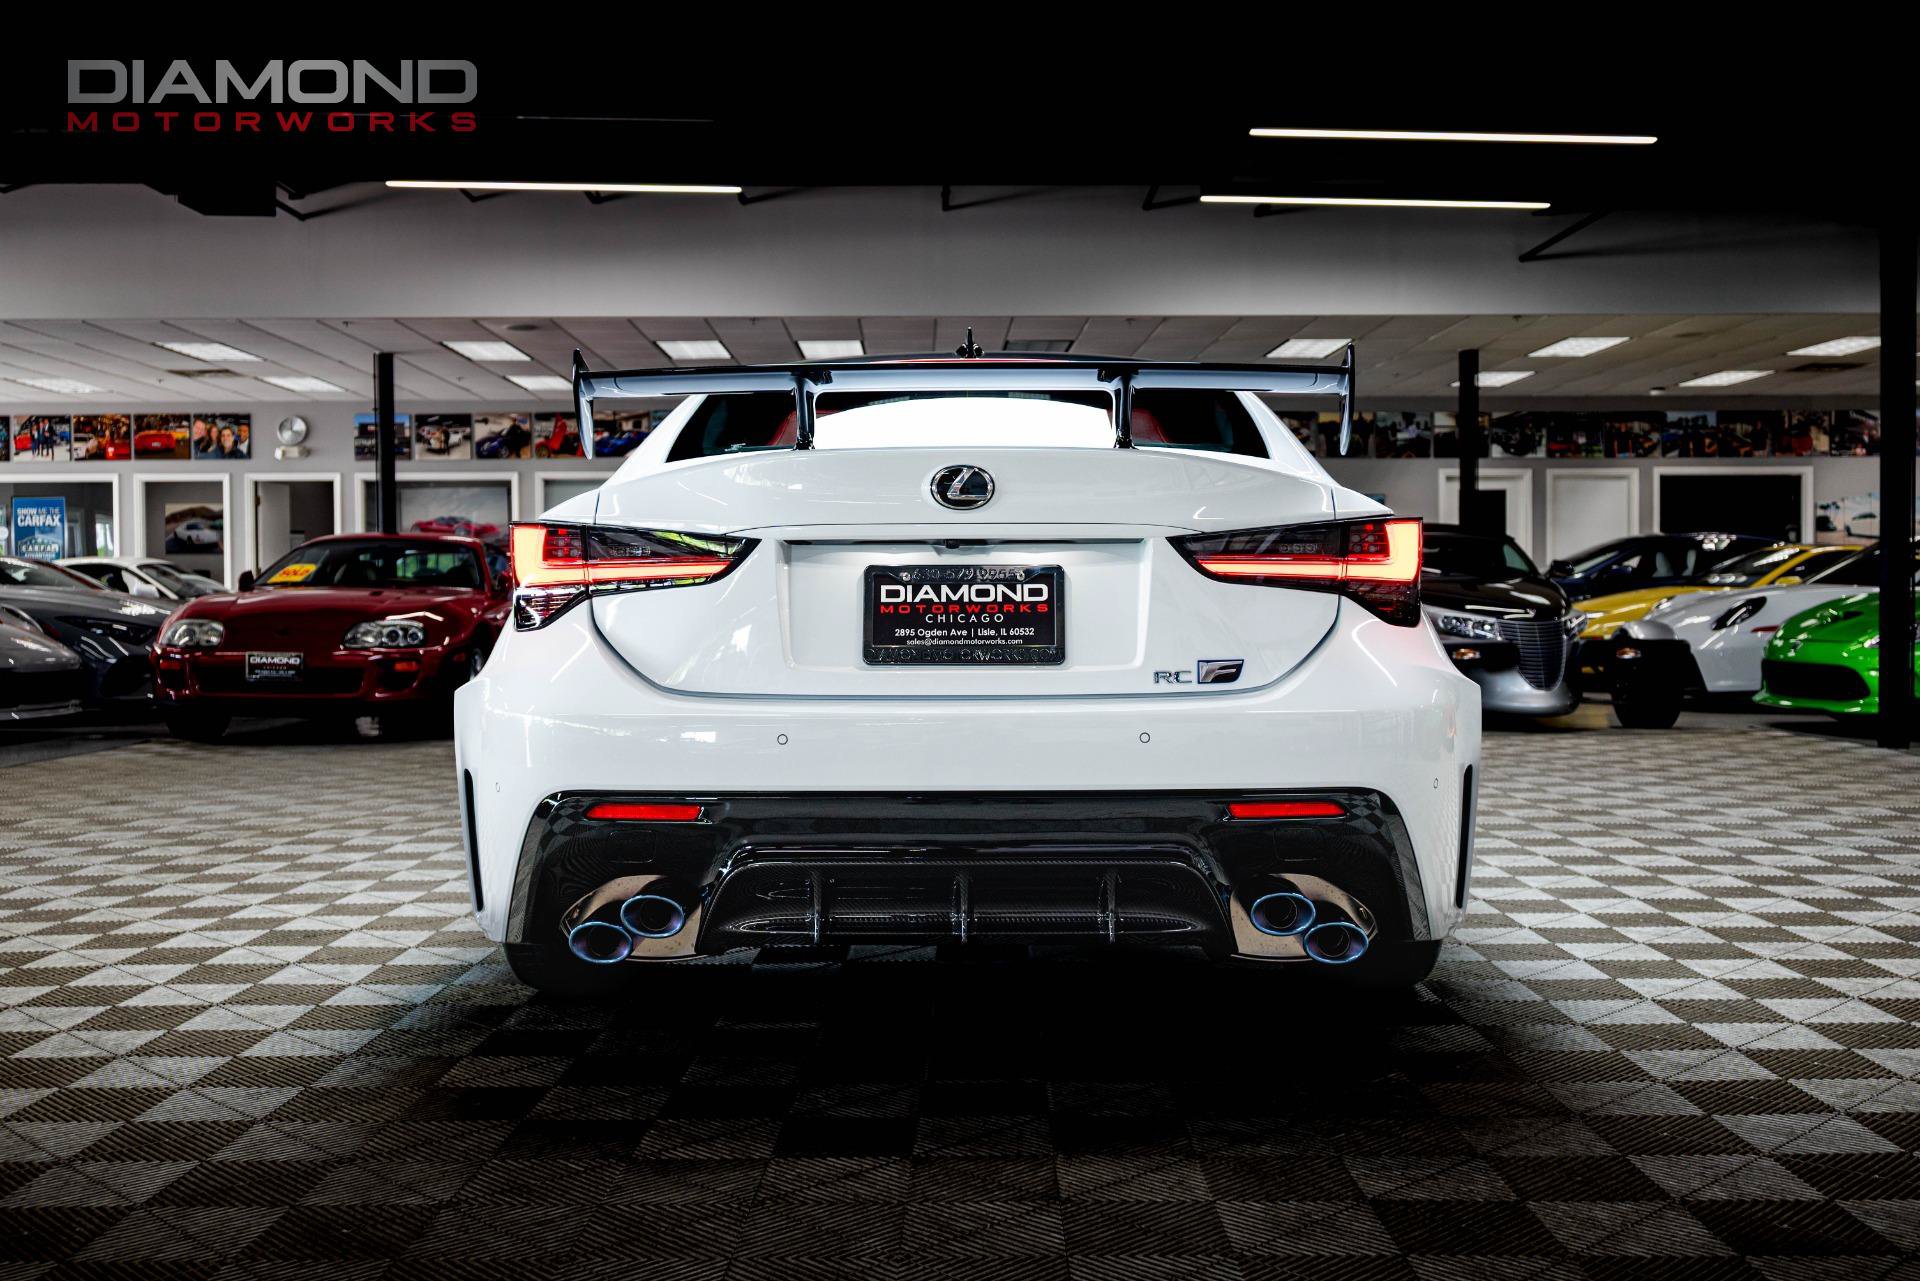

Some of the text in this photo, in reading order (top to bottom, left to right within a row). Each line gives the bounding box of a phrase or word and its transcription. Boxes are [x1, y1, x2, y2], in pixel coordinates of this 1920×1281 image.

[17, 507, 37, 515] SHOW
[17, 514, 61, 527] CARFAX
[881, 584, 1048, 603] DIAMOND
[881, 604, 1048, 613] MOTORWORKS
[925, 613, 1004, 623] CHICAGO
[895, 629, 916, 637] 2895
[917, 628, 948, 638] Ogden
[950, 628, 968, 637] Ave
[1000, 628, 1008, 636] IL
[1009, 627, 1035, 636] 60532
[906, 638, 1023, 646] sales@diamondmotorworks.com
[250, 656, 300, 665] DIAMOND
